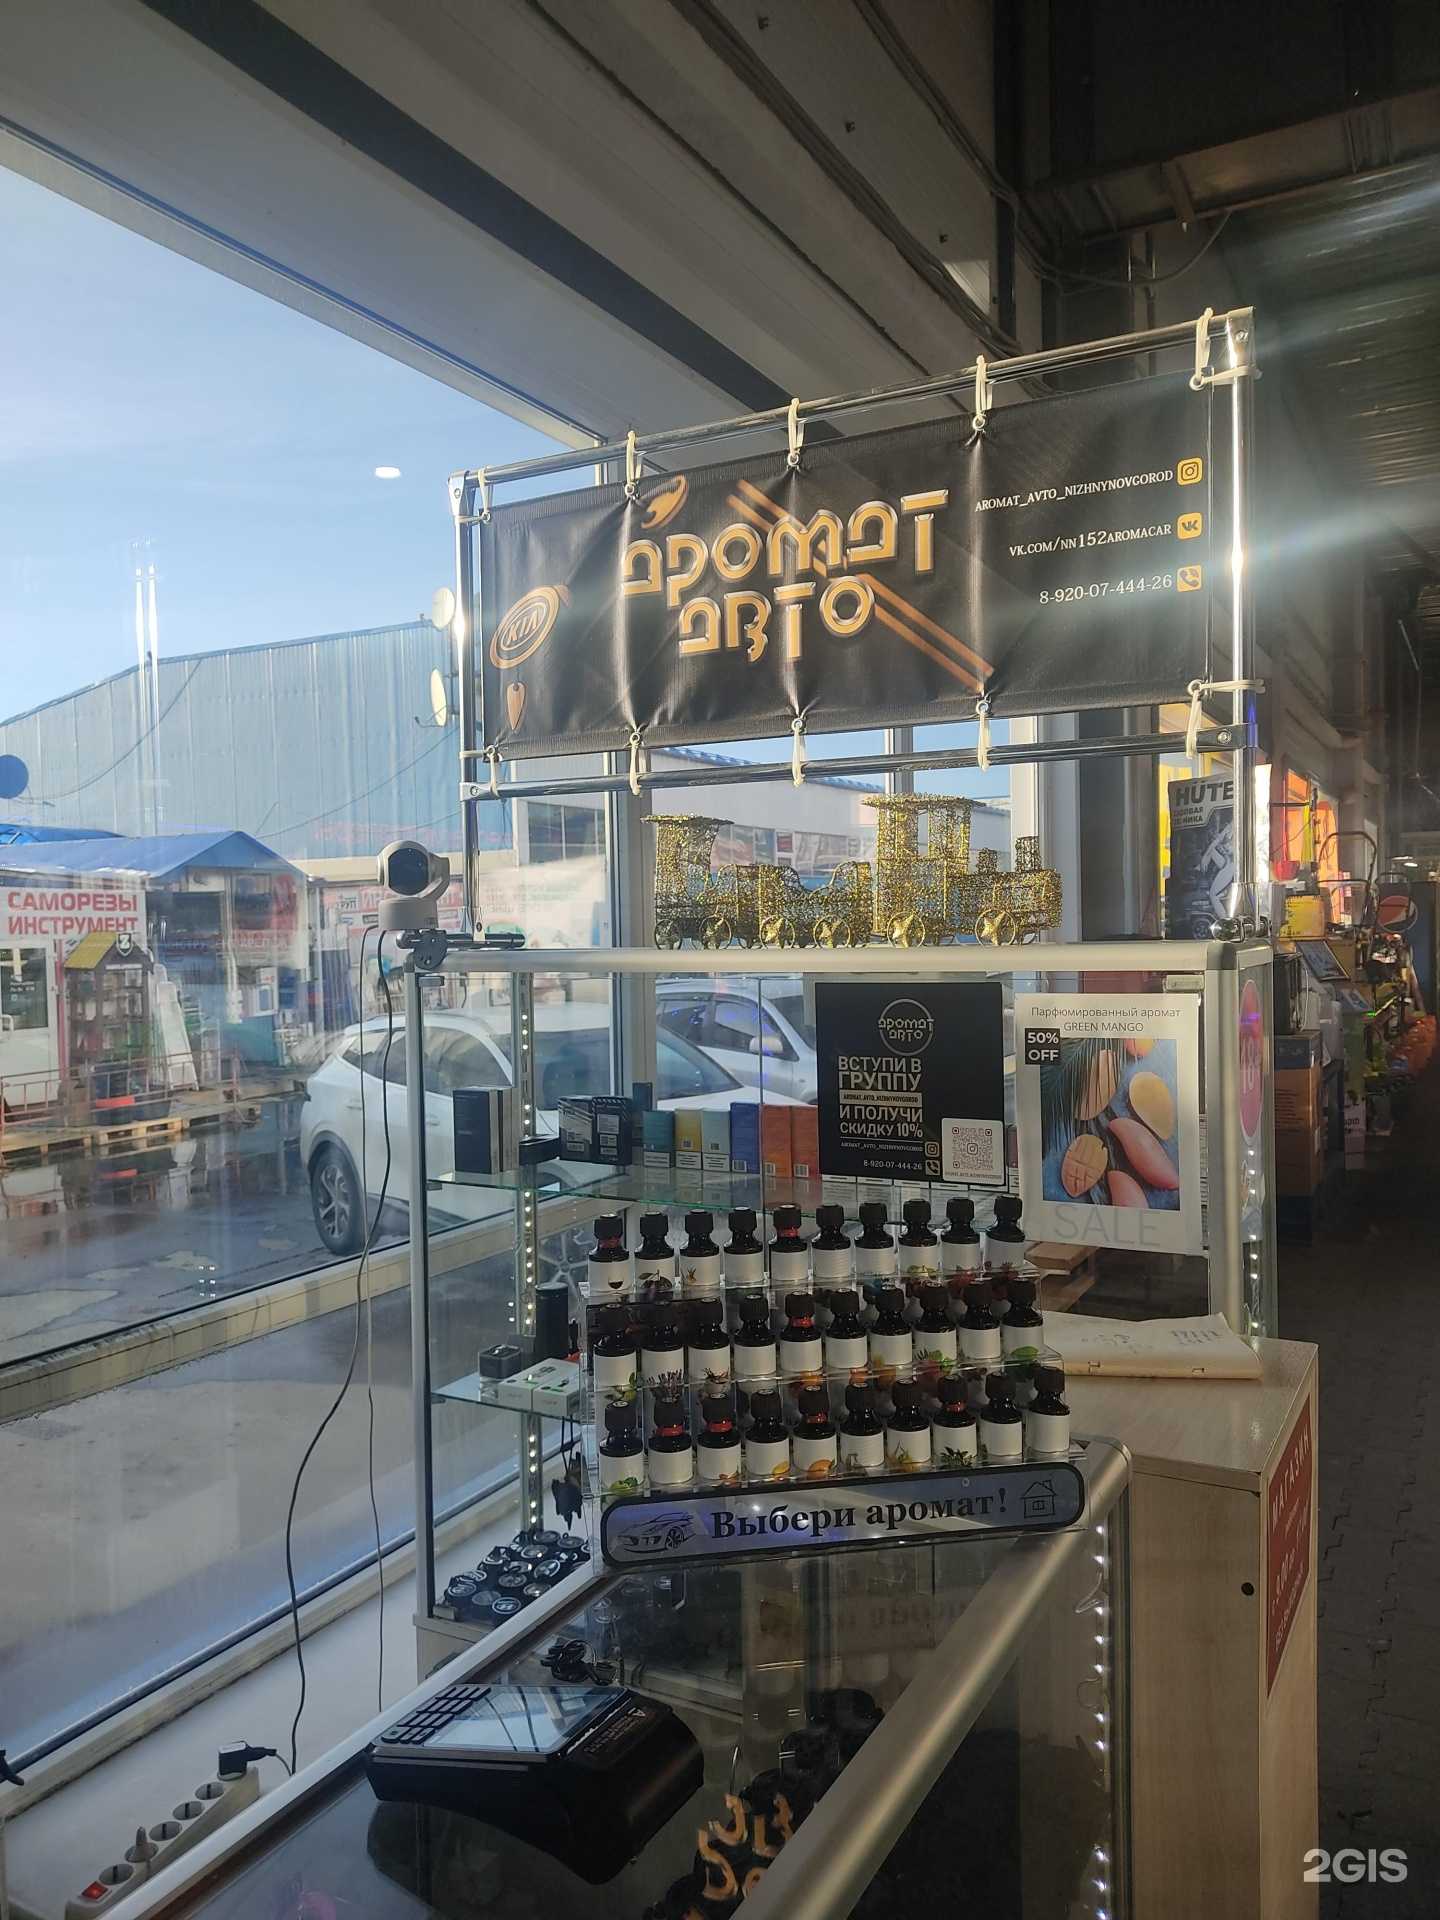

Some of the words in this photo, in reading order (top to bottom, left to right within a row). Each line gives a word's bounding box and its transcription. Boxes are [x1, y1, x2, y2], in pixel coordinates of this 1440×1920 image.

[975, 469, 1173, 512] AROMAT_AVTO_NIZHNYNOVGOROD
[1039, 574, 1172, 604] 8-920-07-444-26
[8, 891, 137, 912] САМОРЕЗЫ
[8, 916, 138, 935] ИНСТРУМЕНТ
[1031, 1007, 1137, 1019] Парфюмированный
[1140, 1008, 1182, 1020] аромат
[1063, 1022, 1099, 1032] GREEN
[1101, 1022, 1144, 1032] MANGO
[1027, 1032, 1059, 1044] 50%
[838, 1055, 906, 1073] ВСТУПИ
[911, 1058, 922, 1073] В
[1028, 1049, 1059, 1062] OFF
[838, 1071, 922, 1092] ГРУППУ
[839, 1104, 850, 1119] И
[854, 1105, 923, 1122] ПОЛУЧИ
[840, 1122, 896, 1137] СКИДКУ
[897, 1124, 923, 1138] 10%
[1054, 1204, 1161, 1247] SALE
[711, 1504, 856, 1538] Выбери
[866, 1487, 1007, 1530] аромат!
